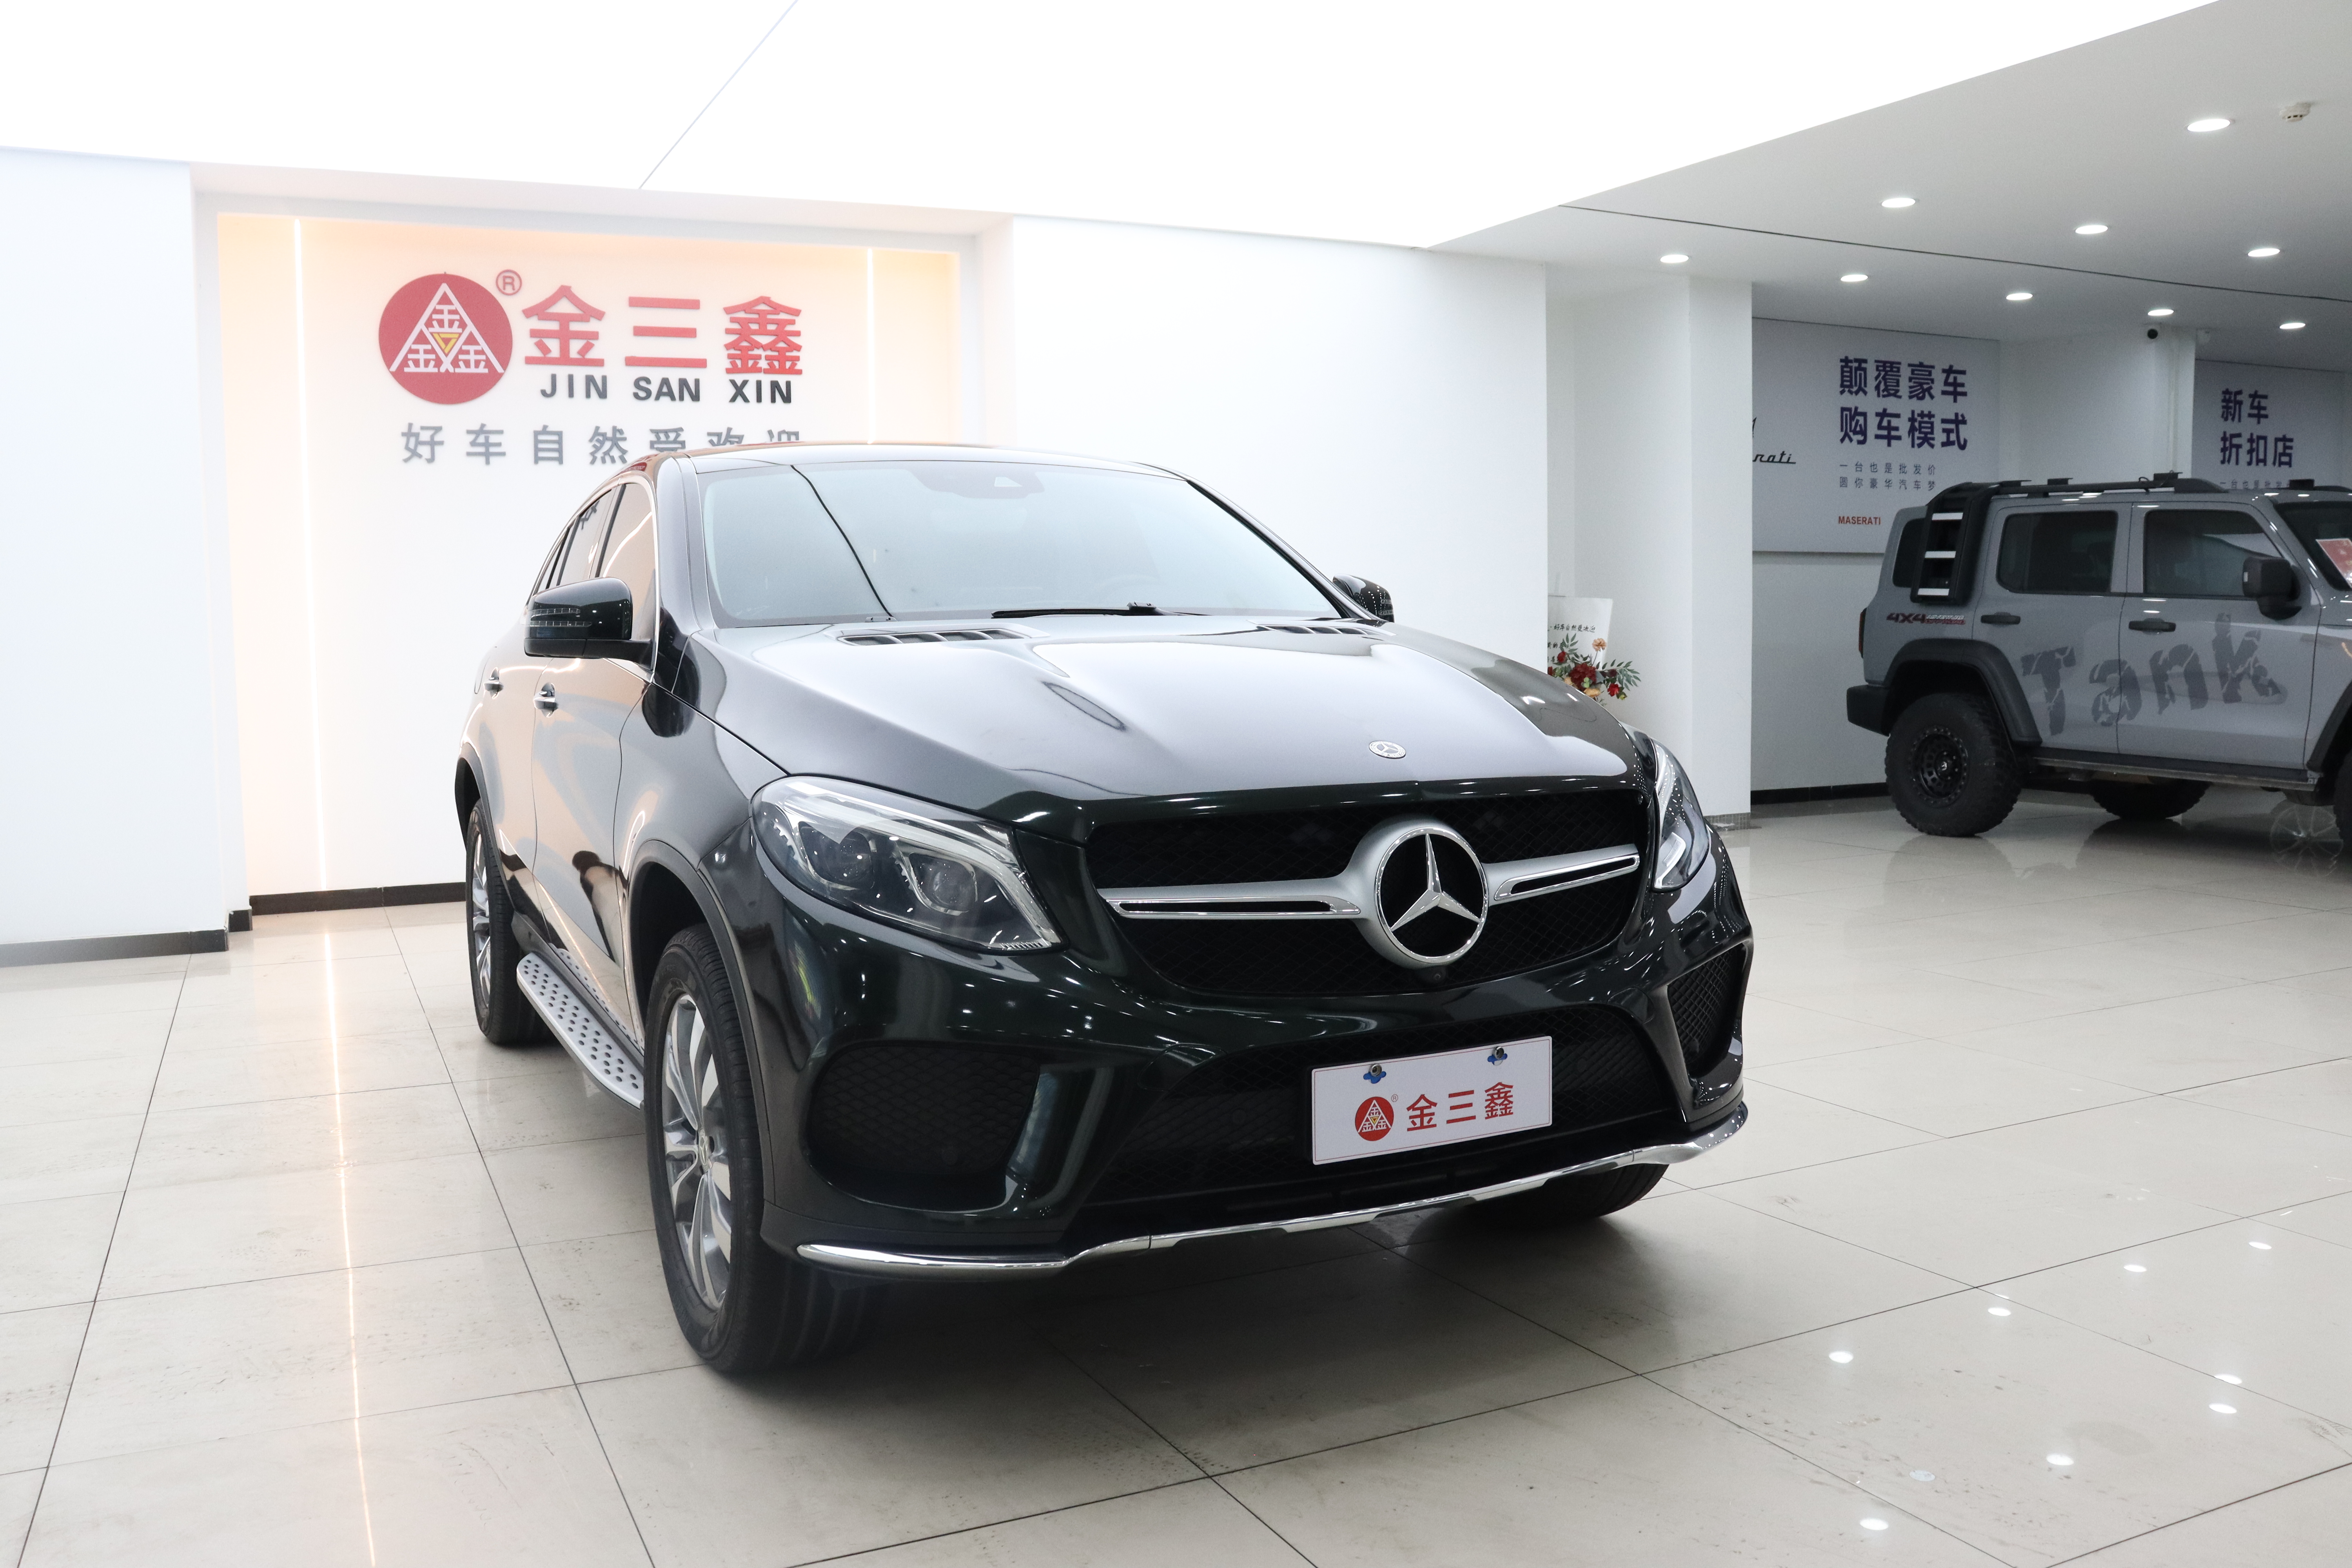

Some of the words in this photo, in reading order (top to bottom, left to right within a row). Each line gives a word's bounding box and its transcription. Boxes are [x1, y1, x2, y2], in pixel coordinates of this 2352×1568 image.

[522, 285, 803, 375] 金三鑫
[541, 374, 607, 399] JIN
[633, 376, 700, 402] SAN
[729, 379, 791, 404] XIN
[1840, 356, 1968, 403] 颠覆豪车
[2221, 388, 2269, 424] 新车
[1840, 406, 1968, 450] 购车模式
[1753, 451, 1797, 464] rati
[2220, 431, 2294, 468] 折扣店
[1838, 516, 1881, 525] MASERATI
[2021, 613, 2282, 735] Tank
[1406, 1082, 1514, 1132] 金三鑫
